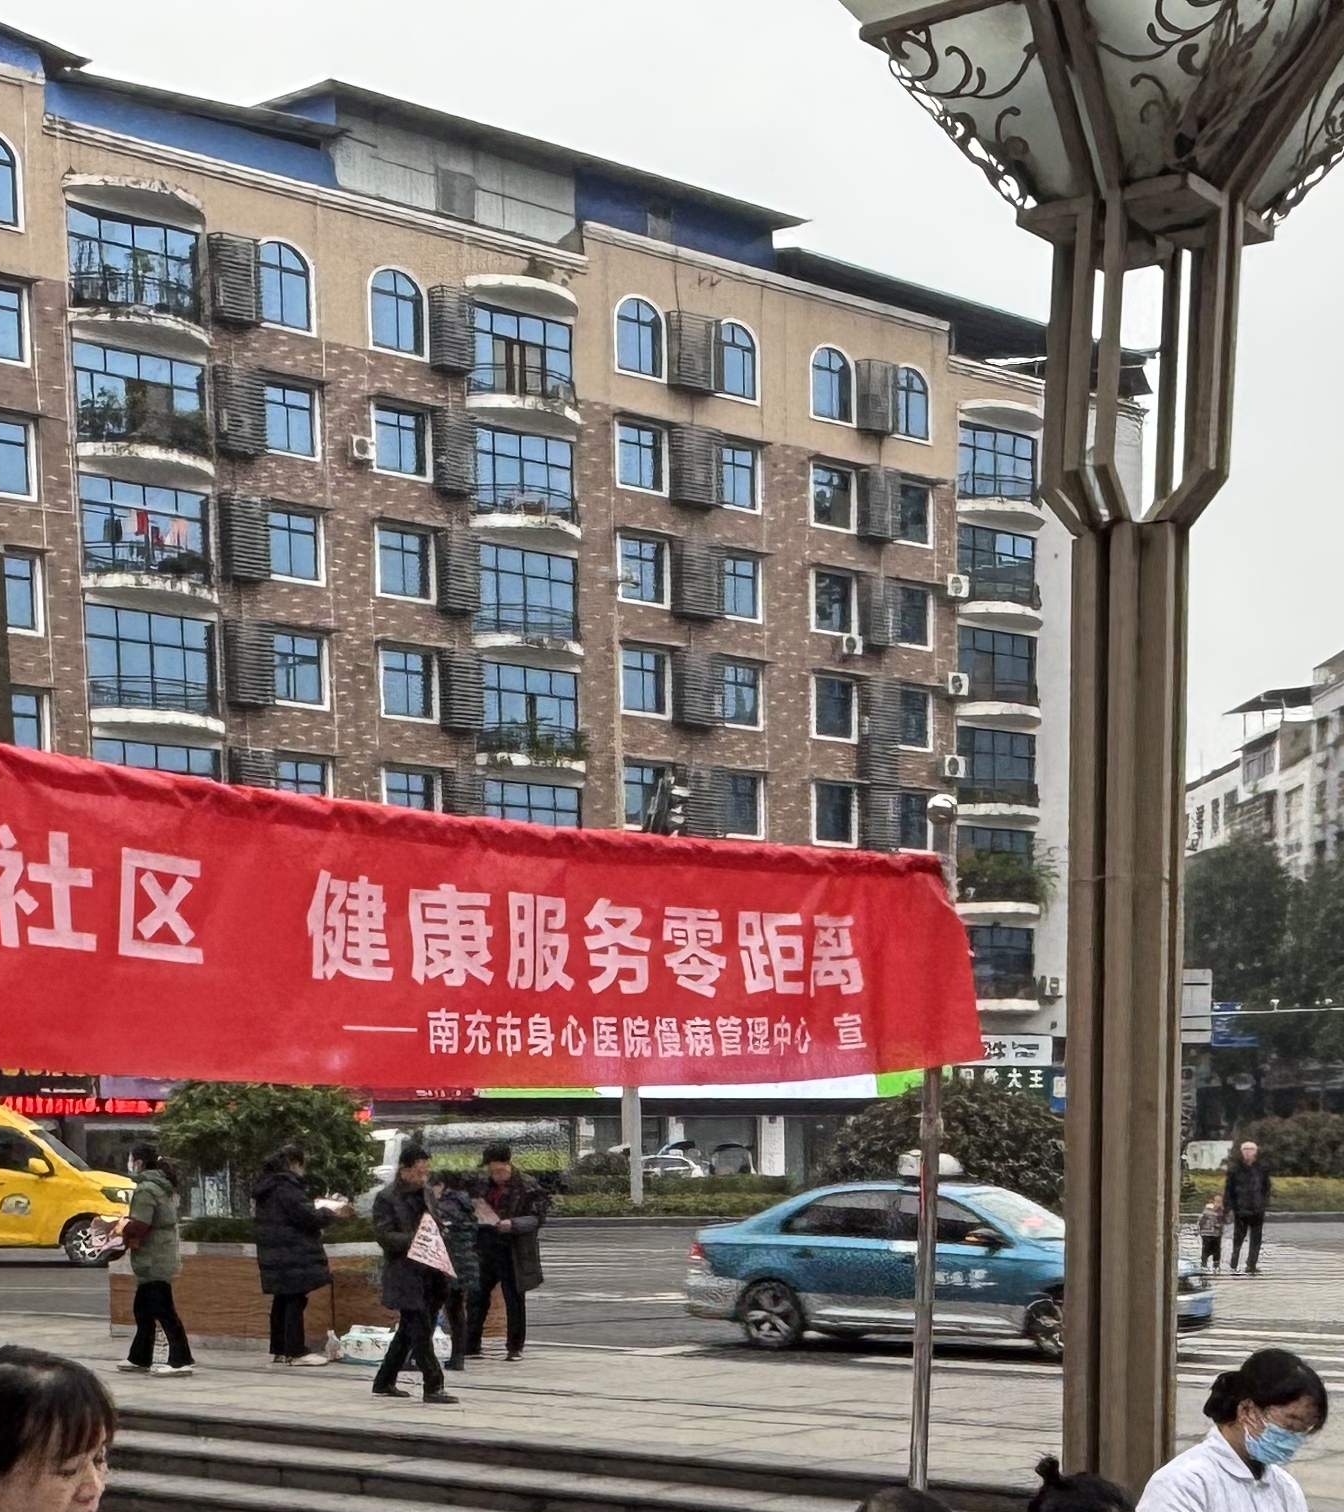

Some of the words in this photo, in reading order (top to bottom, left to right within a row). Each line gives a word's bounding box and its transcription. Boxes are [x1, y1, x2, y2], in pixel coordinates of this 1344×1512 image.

[306, 869, 863, 998] 健康服务零距离
[834, 1013, 867, 1051] 宣
